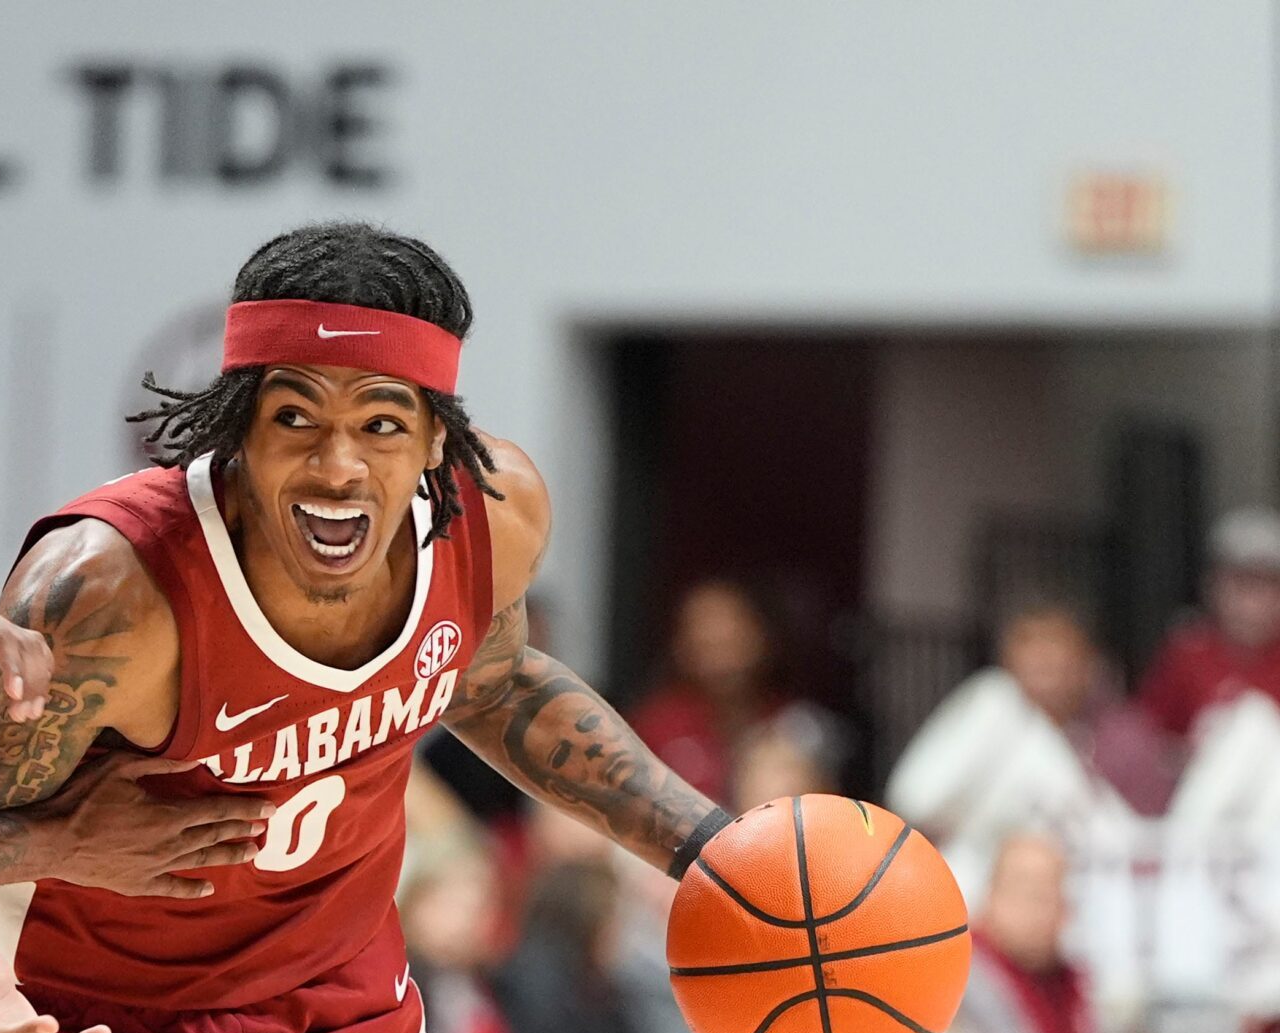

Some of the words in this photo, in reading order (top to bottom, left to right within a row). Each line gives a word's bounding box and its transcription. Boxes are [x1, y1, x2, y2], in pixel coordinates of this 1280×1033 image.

[68, 62, 396, 189] TIDE
[416, 625, 458, 678] SEC
[253, 775, 346, 872] 0
